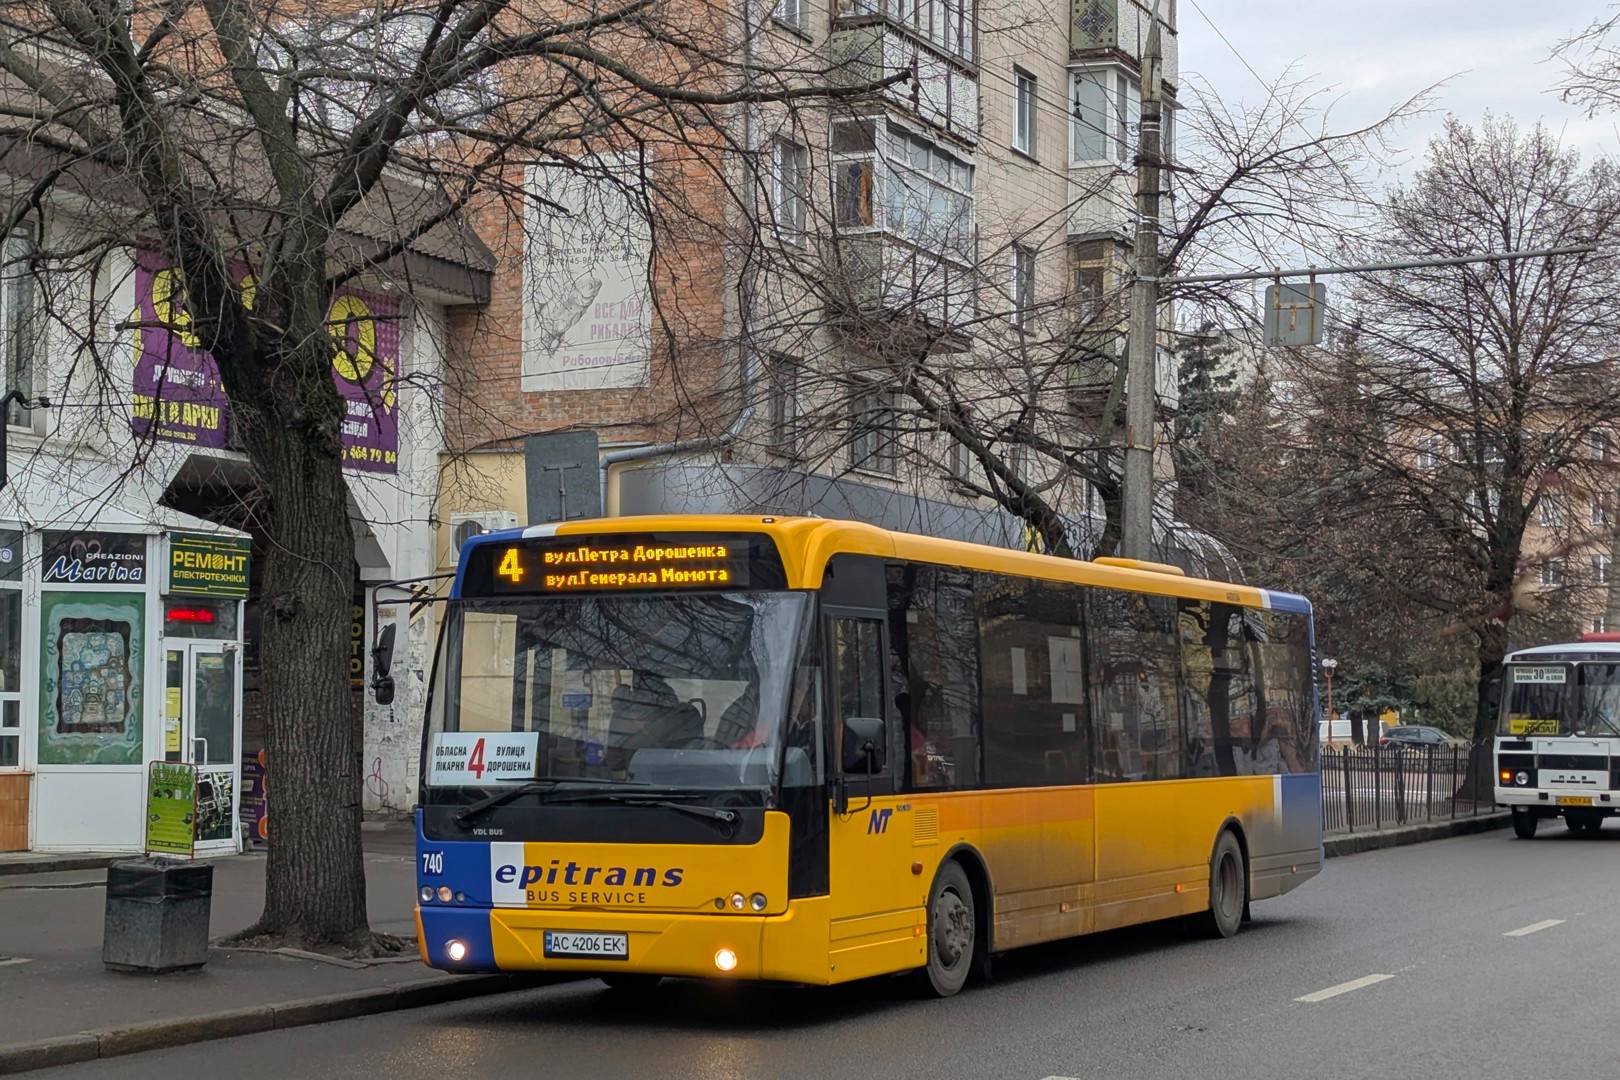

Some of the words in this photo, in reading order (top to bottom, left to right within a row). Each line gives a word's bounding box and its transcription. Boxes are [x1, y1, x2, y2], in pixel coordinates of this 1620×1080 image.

[594, 302, 616, 319] ВСЕ
[86, 552, 144, 561] CREAZIONI
[173, 550, 246, 572] РЕМОНТ
[634, 546, 727, 561] Дорошенка
[43, 555, 143, 583] Marina
[499, 549, 524, 583] 4
[173, 570, 245, 585] ЕЛЕКТРОТЕХНІКИ
[661, 568, 728, 583] Момота
[1534, 668, 1544, 680] 30
[435, 746, 467, 757] ОБЛАСНА
[468, 738, 485, 779] 4
[496, 746, 526, 758] ВУЛИЦЯ
[435, 761, 465, 772] ЛІКАРНЯ
[486, 761, 531, 773] ДОРОШЕНКА
[867, 808, 893, 835] NT
[472, 828, 488, 836] VDL
[489, 828, 503, 836] BUS
[423, 853, 442, 875] 740
[495, 860, 684, 890] epitrans
[526, 891, 560, 903] BUS
[568, 891, 646, 904] SERVICE
[553, 936, 569, 951] AC
[572, 937, 601, 952] 4206
[603, 937, 621, 952] EK
